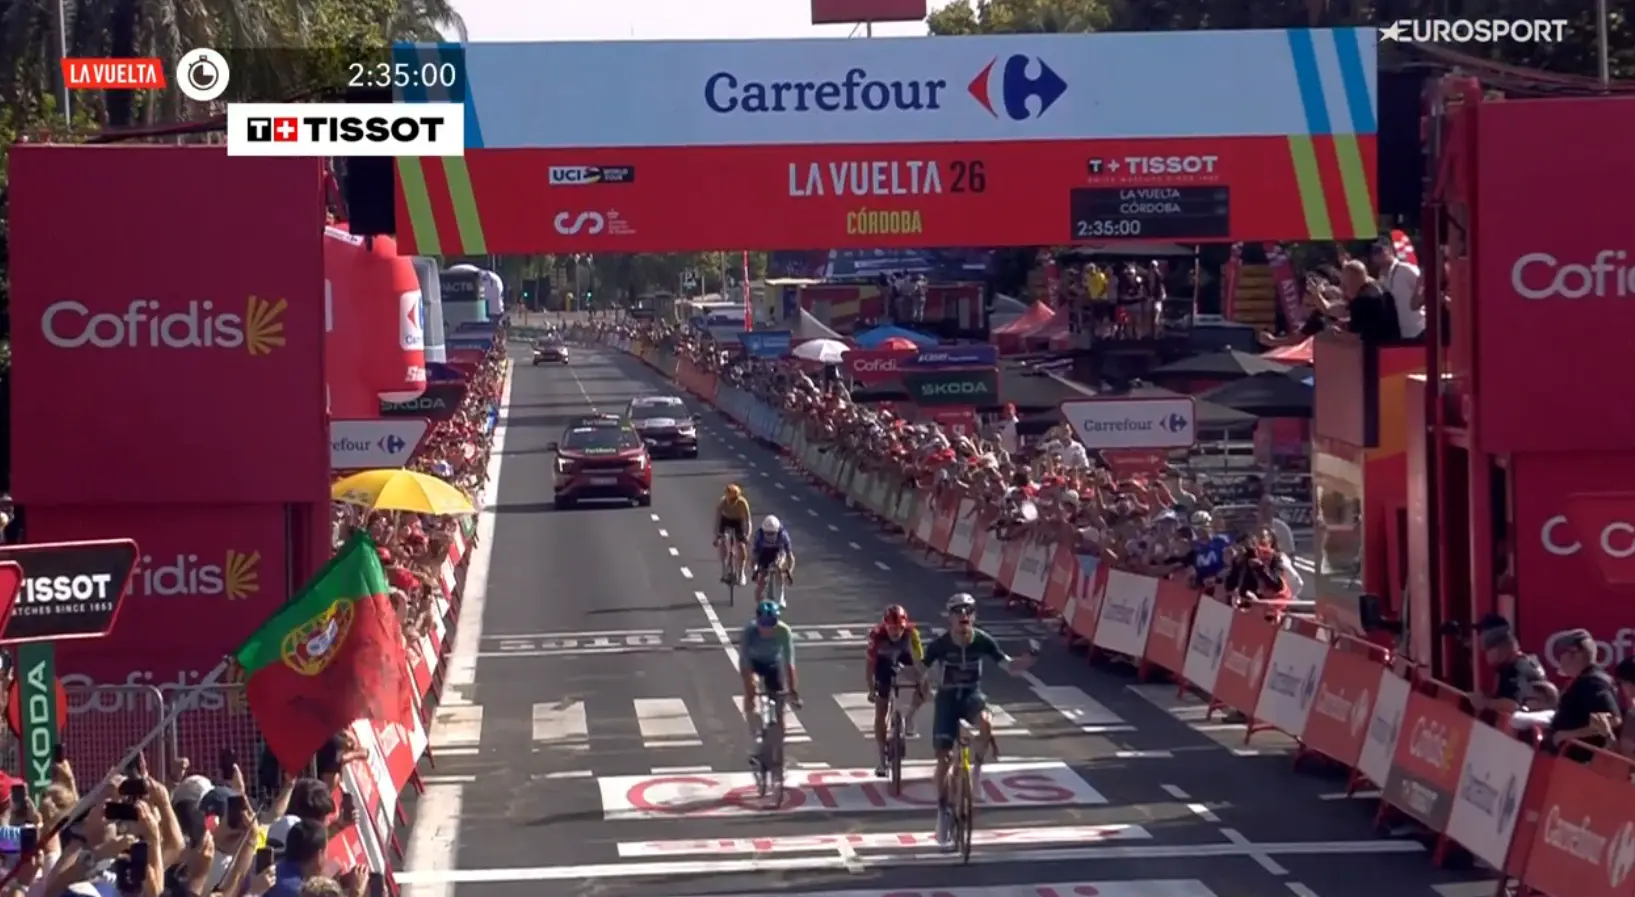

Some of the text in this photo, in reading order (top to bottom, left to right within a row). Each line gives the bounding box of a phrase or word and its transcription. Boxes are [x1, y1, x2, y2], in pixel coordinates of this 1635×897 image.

[704, 69, 946, 114] Carrefour
[1125, 156, 1218, 174] TISSOT
[553, 169, 581, 181] UCI
[789, 160, 986, 196] LA VUELTA 26
[1120, 188, 1180, 200] LA VUELTA
[847, 207, 922, 235] CÓRDOBA
[1077, 220, 1141, 236] 2:35:00
[41, 300, 244, 348] Cofidis
[853, 358, 898, 372] Cofidi
[1084, 419, 1153, 432] Carrefour
[331, 438, 371, 452] efour
[11, 605, 51, 616] ATCHES
[55, 603, 85, 613] SINCE
[28, 660, 52, 803] KODA
